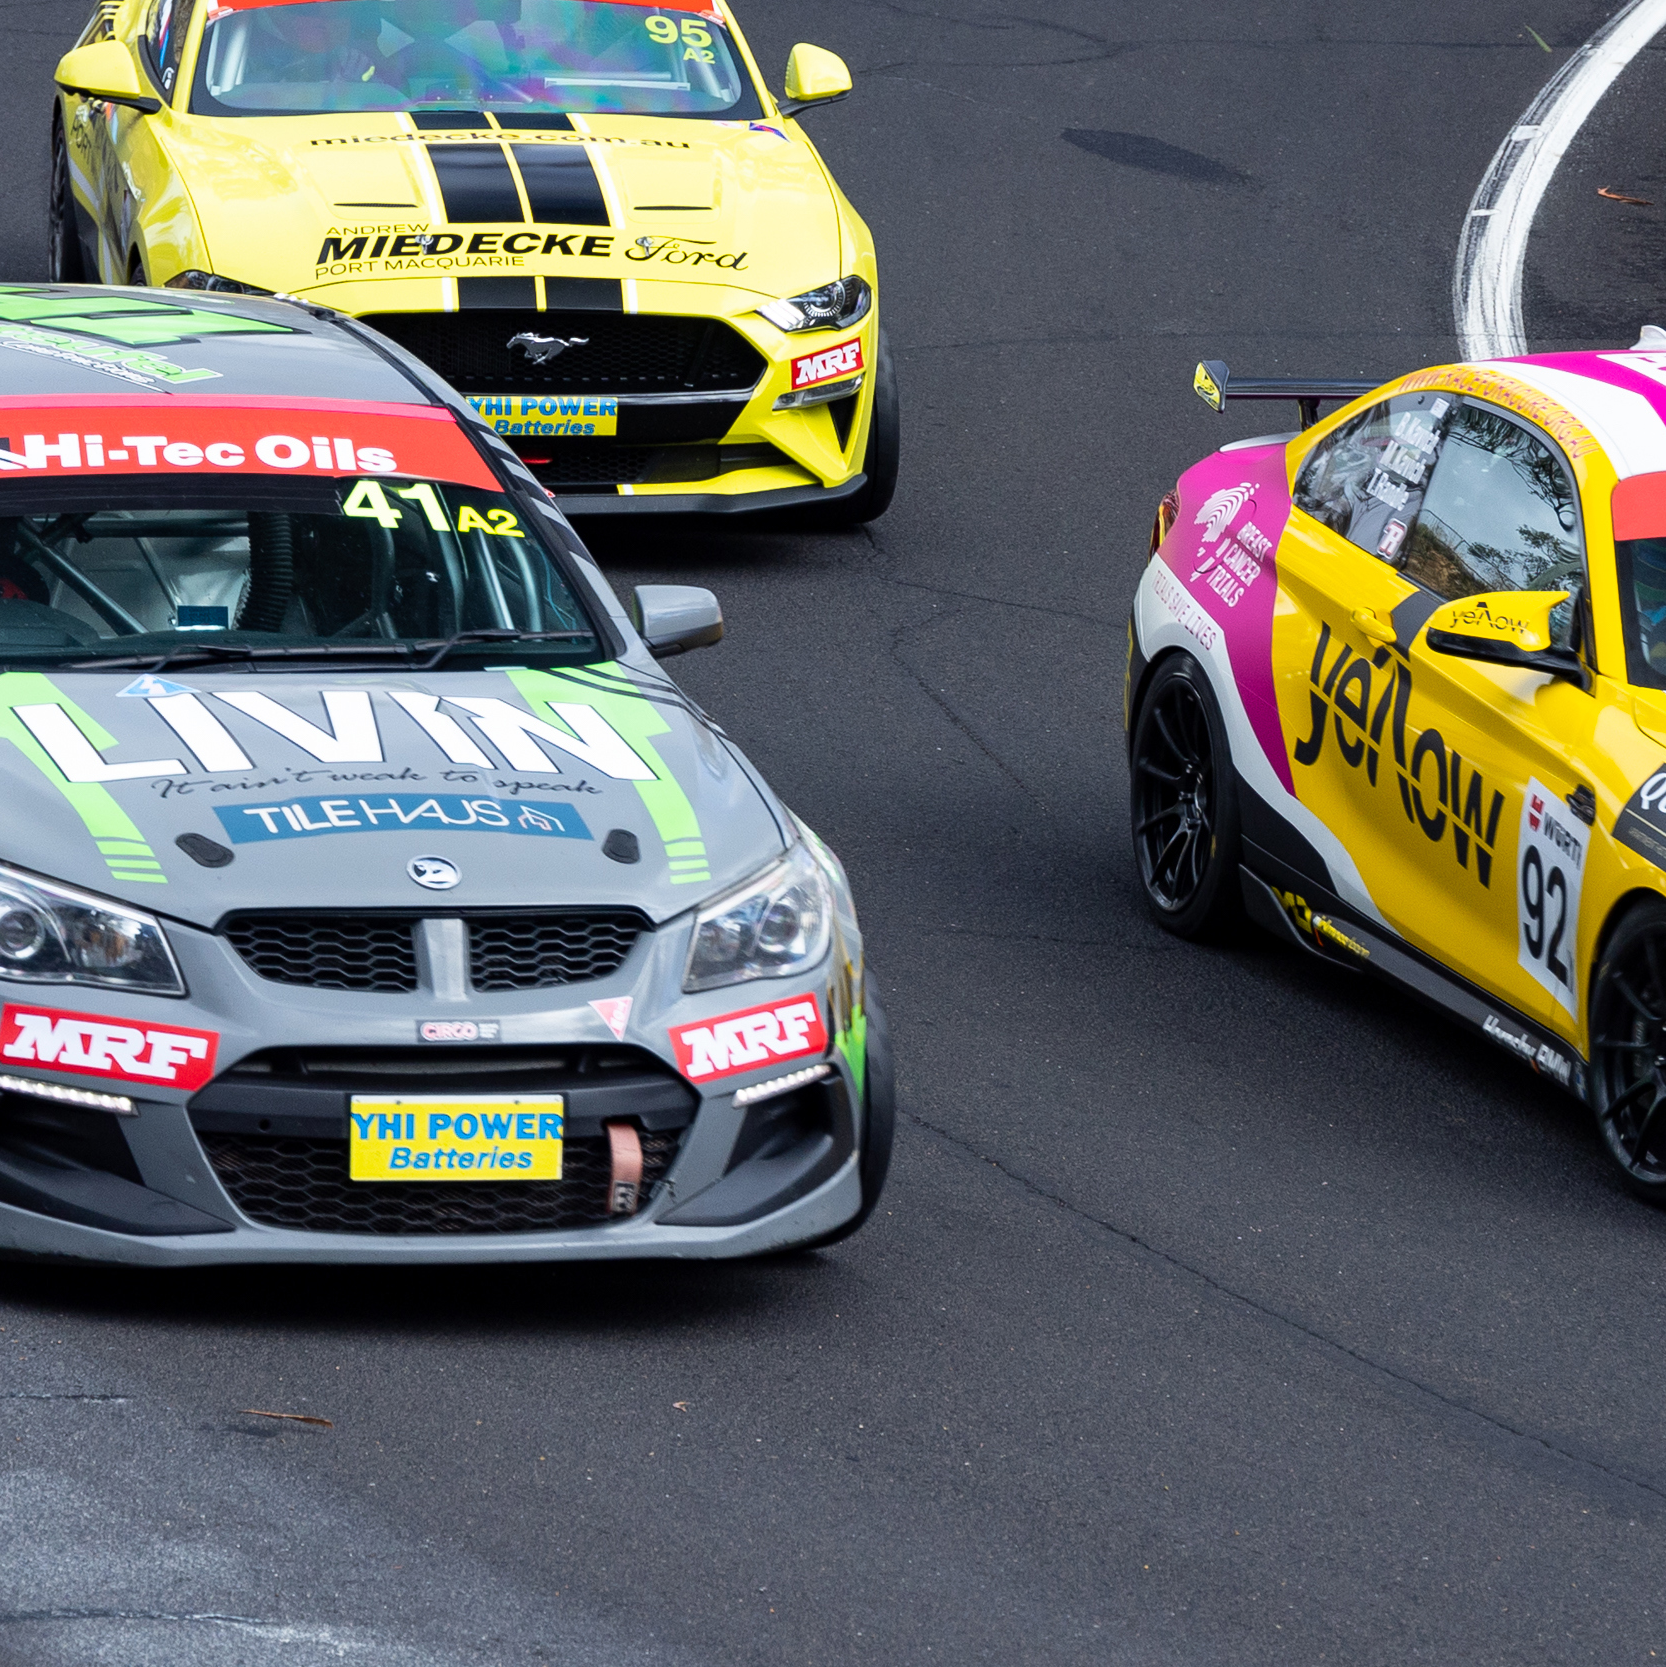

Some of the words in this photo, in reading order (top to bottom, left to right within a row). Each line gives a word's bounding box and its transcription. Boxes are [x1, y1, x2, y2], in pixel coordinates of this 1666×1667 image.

[644, 15, 712, 47] 95
[683, 49, 715, 64] A2
[310, 129, 690, 149] miedecke.com.au
[326, 223, 429, 236] ANDREW
[315, 260, 380, 280] PORT
[384, 255, 525, 272] MACQUARIE
[316, 232, 616, 266] MIEDECKE
[624, 235, 749, 272] Ford
[794, 339, 861, 385] MRF
[470, 399, 511, 417] YHI
[520, 398, 618, 417] POWER
[494, 419, 595, 436] Batteries
[23, 433, 247, 470] Hi-Tec
[255, 434, 397, 473] Oils
[343, 481, 451, 532] 41
[457, 505, 525, 538] A2
[1222, 543, 1262, 587] CANCER
[1206, 564, 1245, 608] TRIALS
[12, 690, 661, 783] LIVIN
[209, 768, 313, 793] ain't
[329, 768, 427, 783] weak
[440, 769, 482, 784] to
[493, 777, 603, 797] speak
[1521, 845, 1570, 988] 92
[3, 1012, 209, 1080] MRF
[679, 1000, 818, 1079] MRF
[351, 1113, 423, 1140] YHI
[429, 1113, 563, 1140] POWER
[388, 1146, 533, 1171] Batteries
